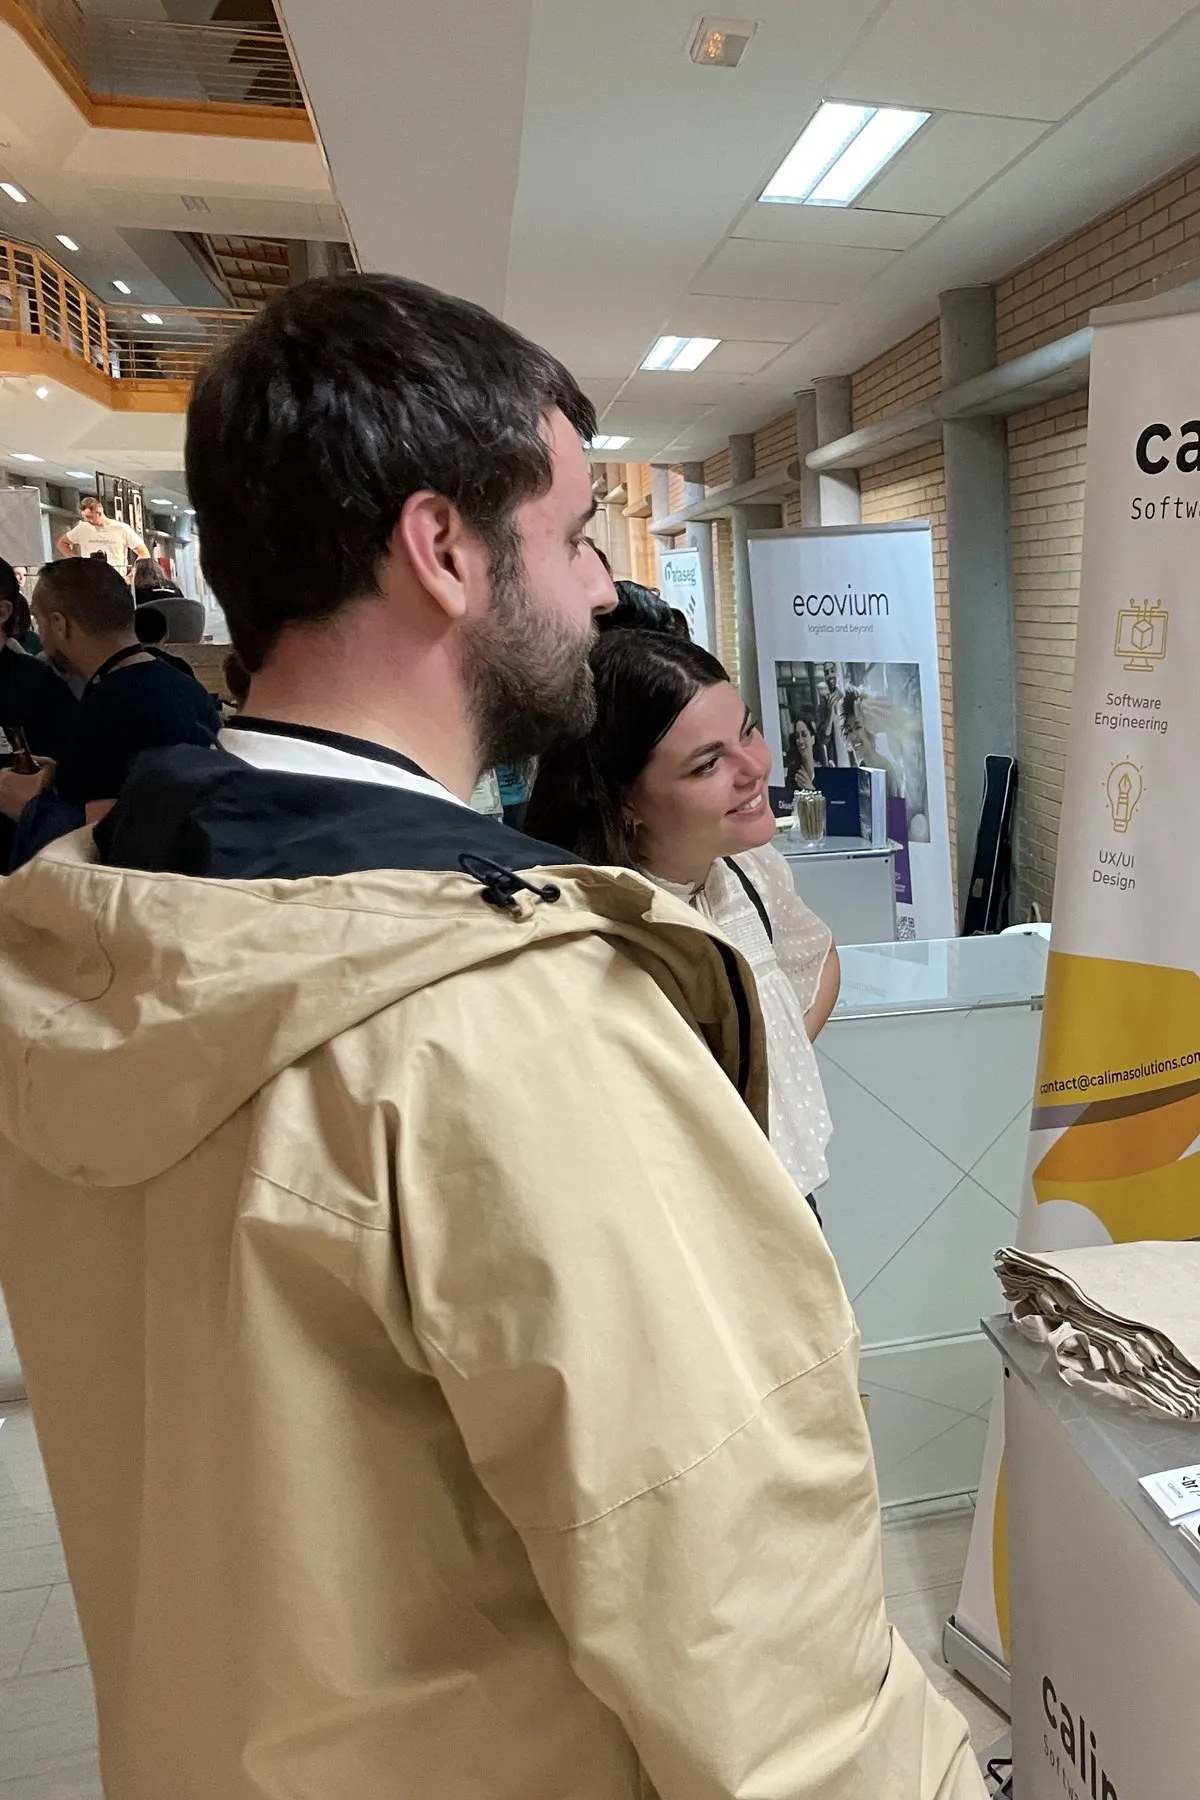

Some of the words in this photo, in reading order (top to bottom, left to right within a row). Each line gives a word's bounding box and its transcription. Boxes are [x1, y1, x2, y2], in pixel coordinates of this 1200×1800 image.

[793, 583, 889, 616] ecovium
[808, 624, 834, 635] logistics
[835, 624, 848, 632] and
[850, 624, 873, 636] beyond
[1106, 693, 1162, 709] Software
[1094, 712, 1168, 734] Engineering
[1098, 850, 1135, 868] UX/UI
[1092, 870, 1136, 890] Design
